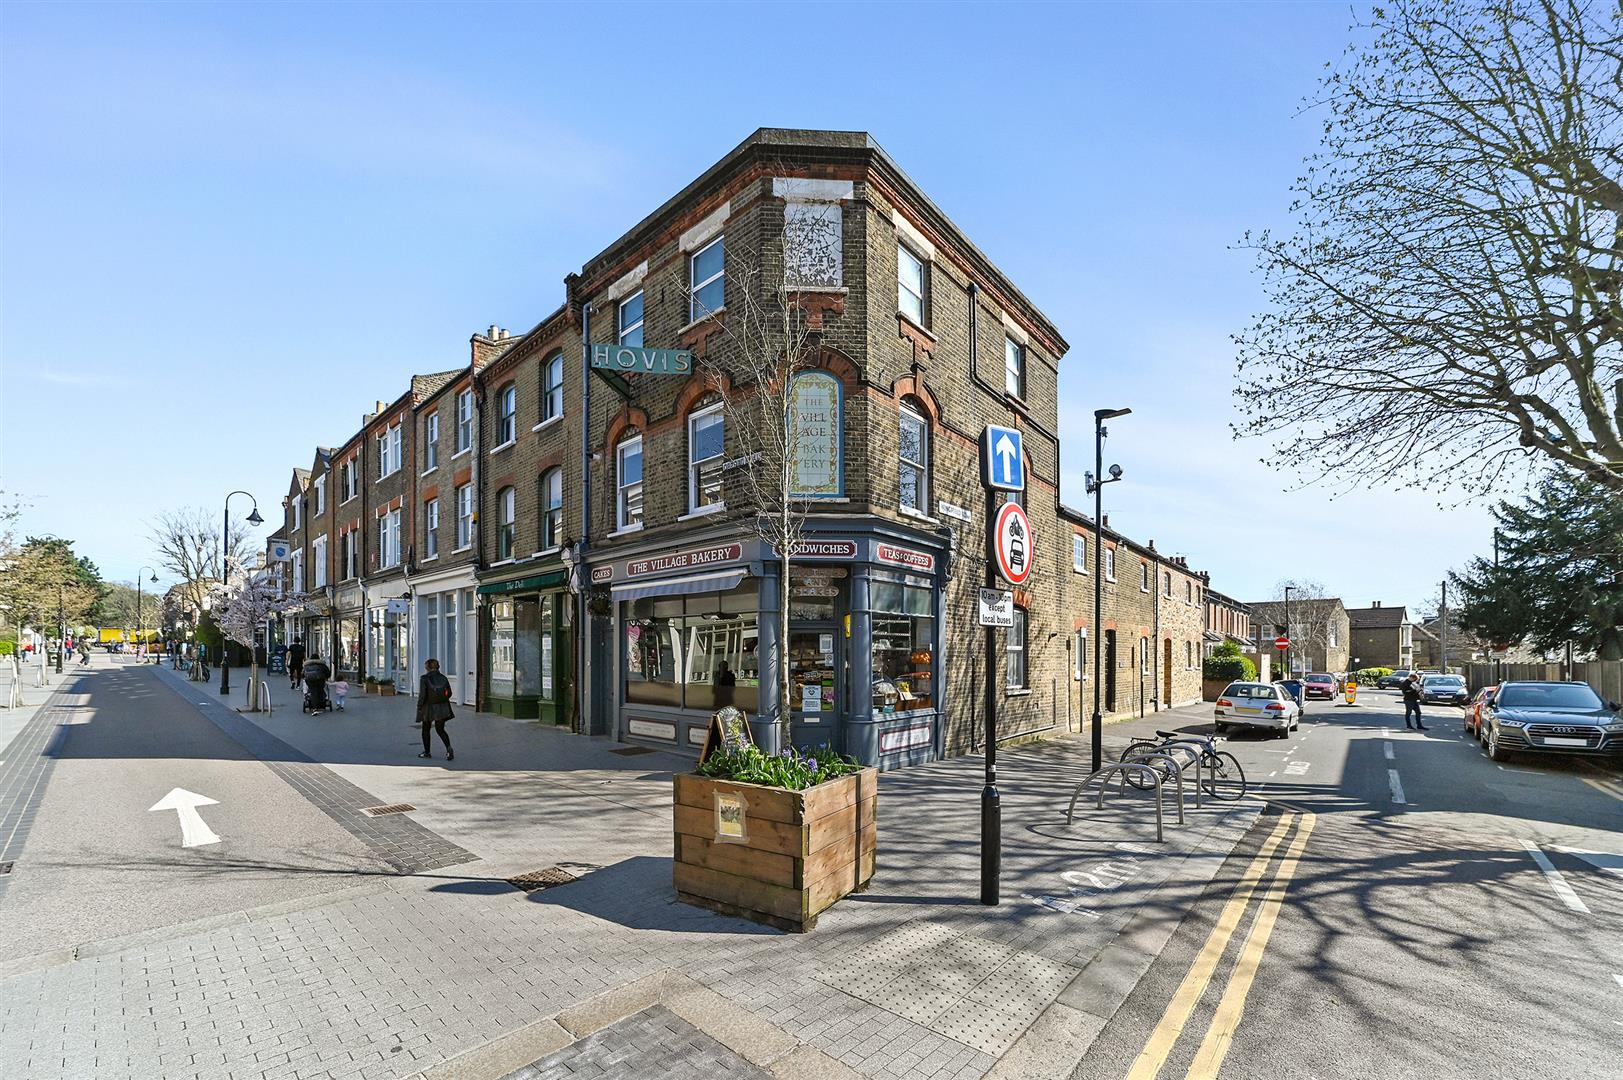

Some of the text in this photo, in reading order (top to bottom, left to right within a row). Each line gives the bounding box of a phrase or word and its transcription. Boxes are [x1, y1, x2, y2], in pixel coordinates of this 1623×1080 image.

[594, 346, 688, 371] HOVIS
[804, 398, 824, 406] THE
[801, 427, 827, 437] AGE
[803, 444, 826, 454] BAK
[804, 459, 825, 469] ERY
[780, 544, 850, 554] ANDWICHES
[883, 548, 900, 560] TEAS
[633, 547, 732, 574] THE VILLAGE BAKERY
[593, 569, 611, 579] CAKES
[989, 604, 1006, 613] except
[982, 613, 1012, 625] local buses
